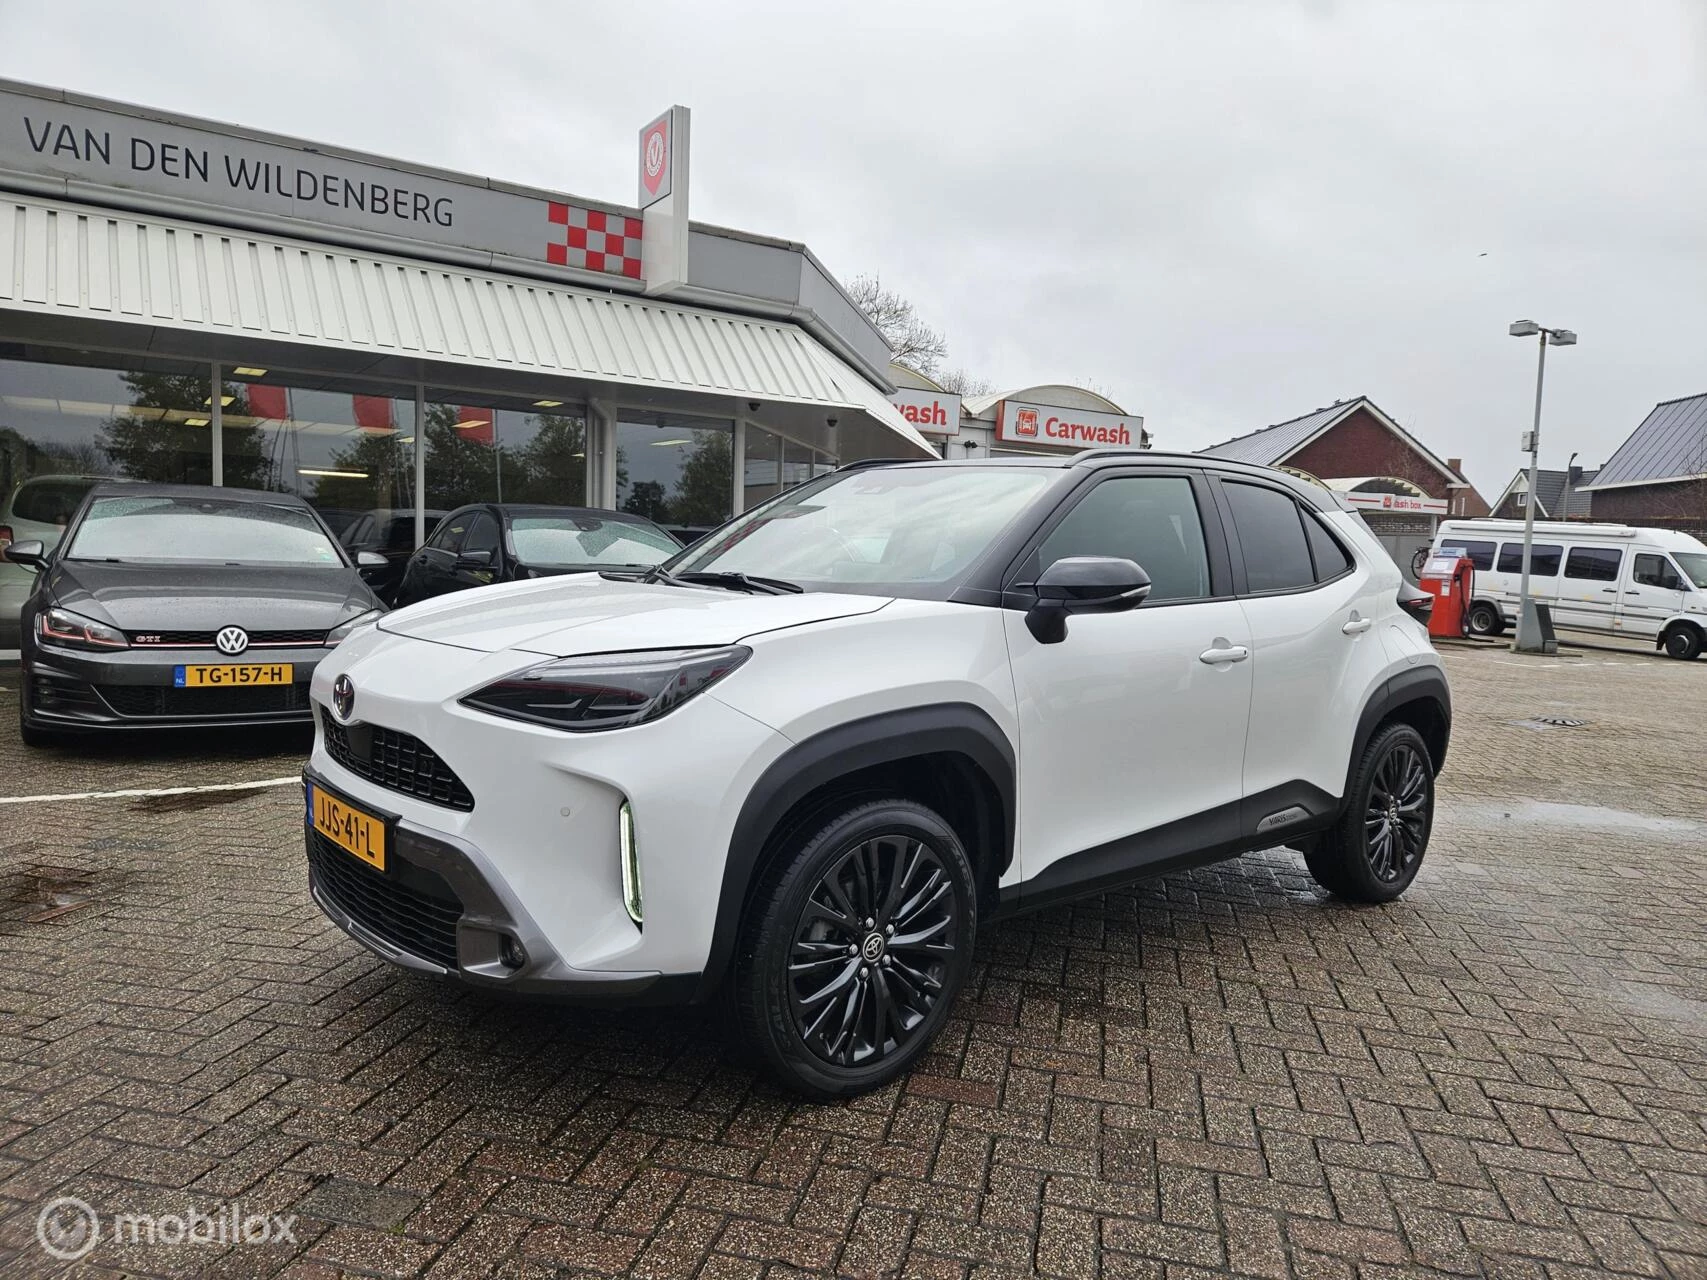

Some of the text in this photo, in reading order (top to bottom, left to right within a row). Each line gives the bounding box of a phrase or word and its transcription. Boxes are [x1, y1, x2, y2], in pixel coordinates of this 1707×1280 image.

[23, 116, 453, 227] VAN DEN WILDENBERG
[1045, 416, 1130, 446] Carwash
[136, 635, 161, 643] GTI
[195, 667, 283, 684] TG-157-H
[319, 796, 376, 859] JJS-41-L
